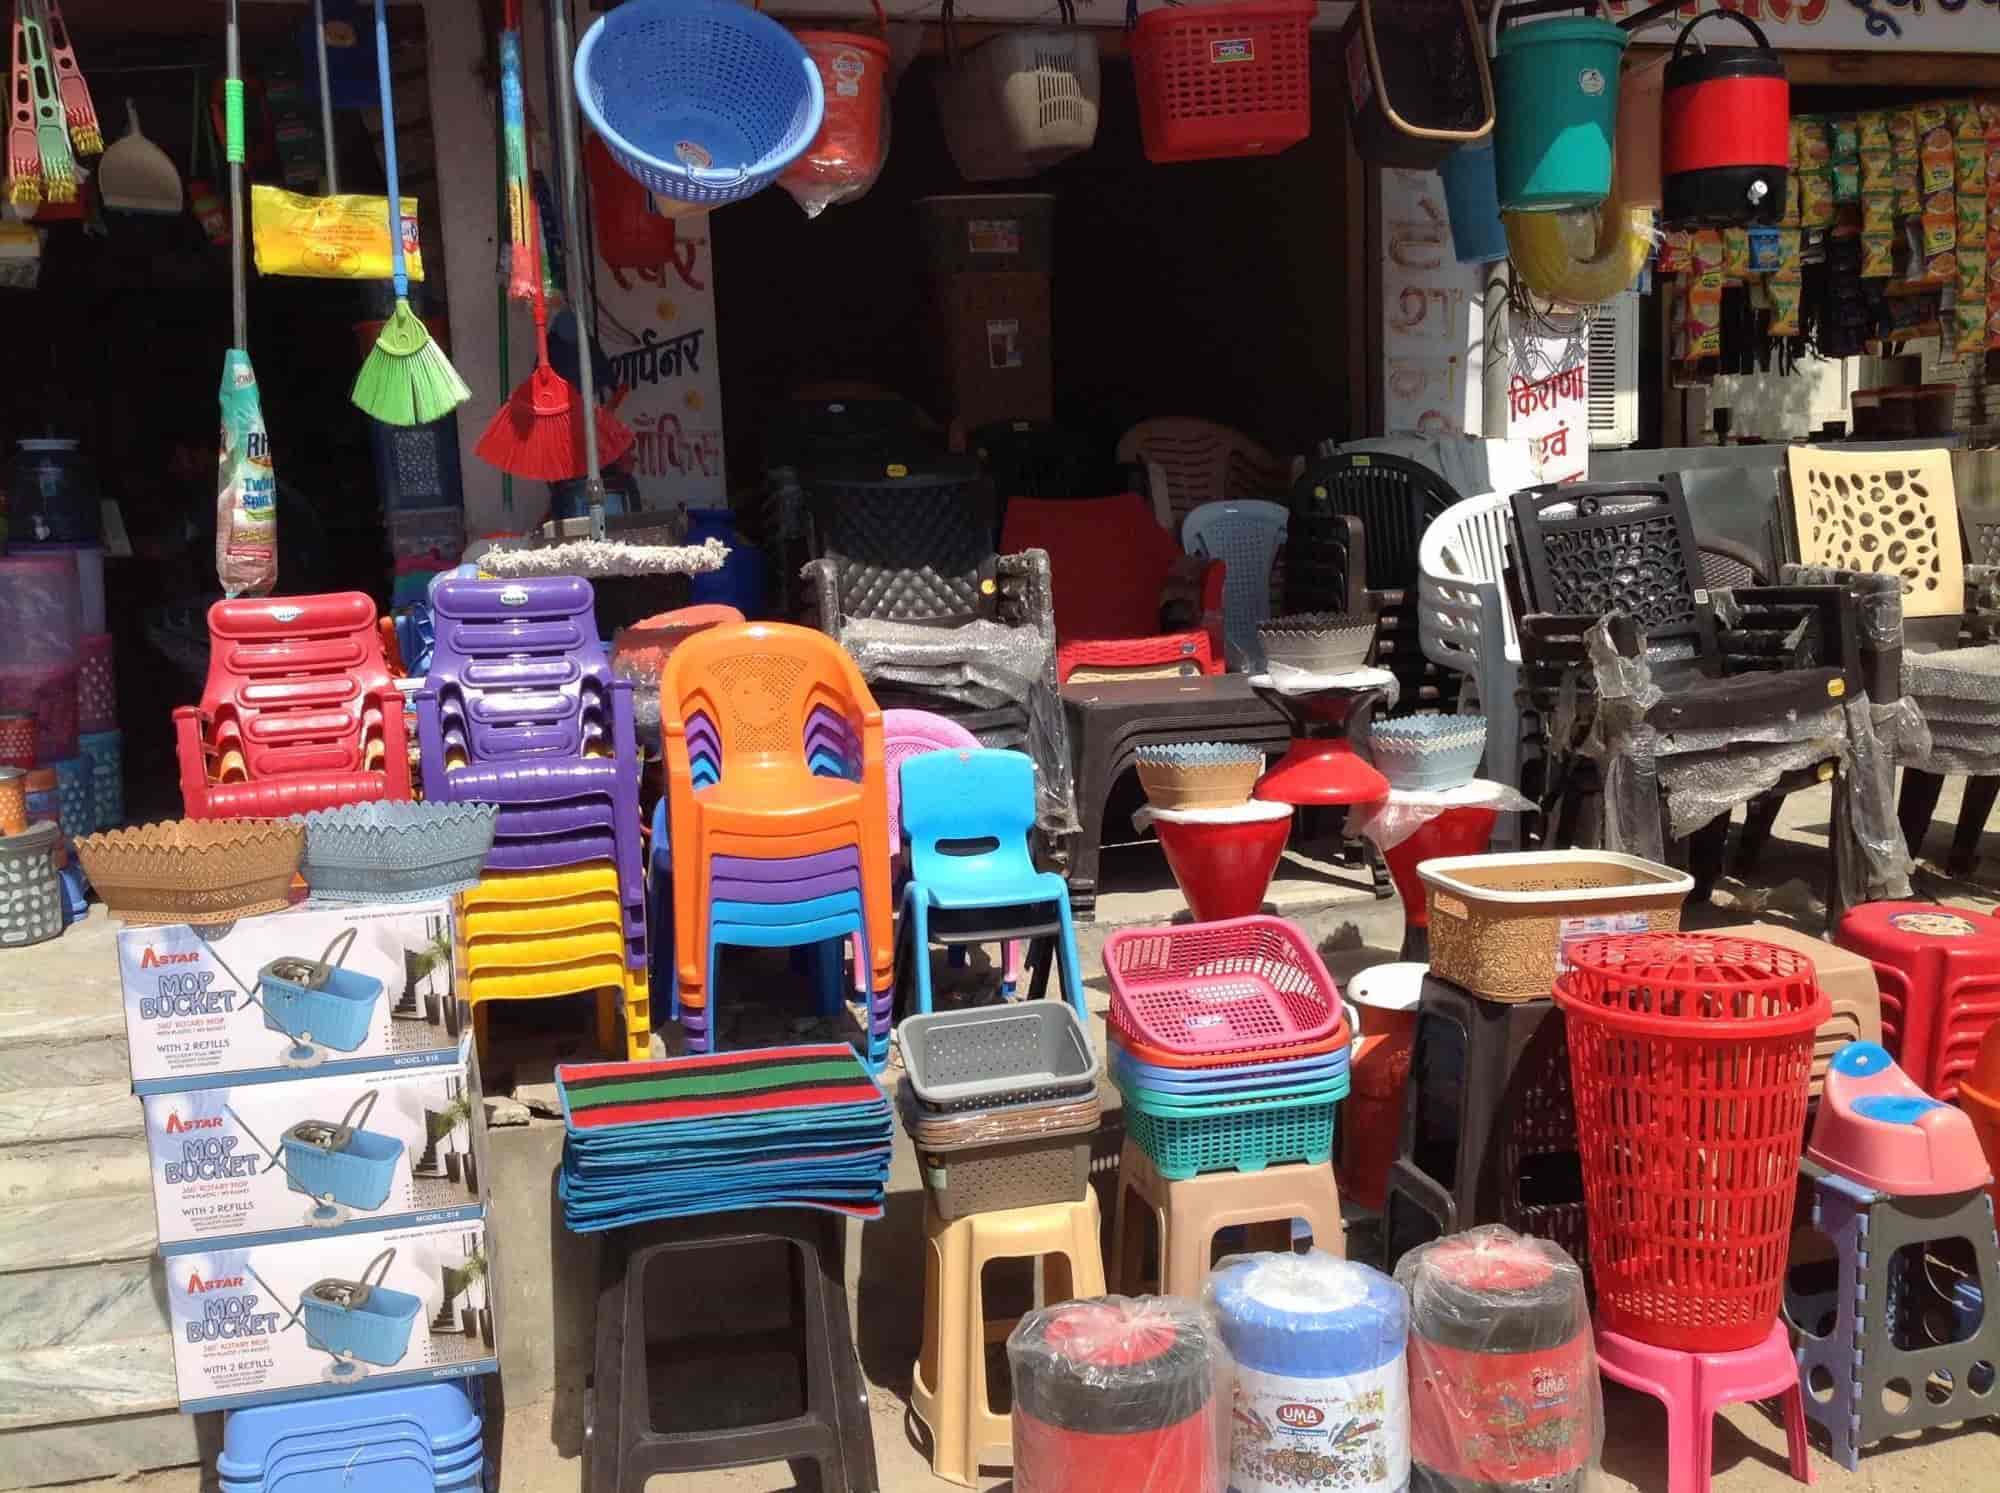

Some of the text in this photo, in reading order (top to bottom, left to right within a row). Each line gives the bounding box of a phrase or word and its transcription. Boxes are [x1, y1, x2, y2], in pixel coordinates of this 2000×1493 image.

[158, 971, 215, 997] MOP
[140, 990, 237, 1019] BUCKET
[157, 1039, 230, 1053] WITH 2 REFILLS
[182, 1136, 239, 1162] MOP
[165, 1154, 260, 1184] BUCKET
[182, 1201, 254, 1216] WITH 2 REFILLS
[204, 1295, 258, 1320] MOP
[186, 1312, 280, 1343] BUCKET
[203, 1358, 274, 1375] WITH 2 REFILLS
[1281, 1407, 1319, 1423] UMA
